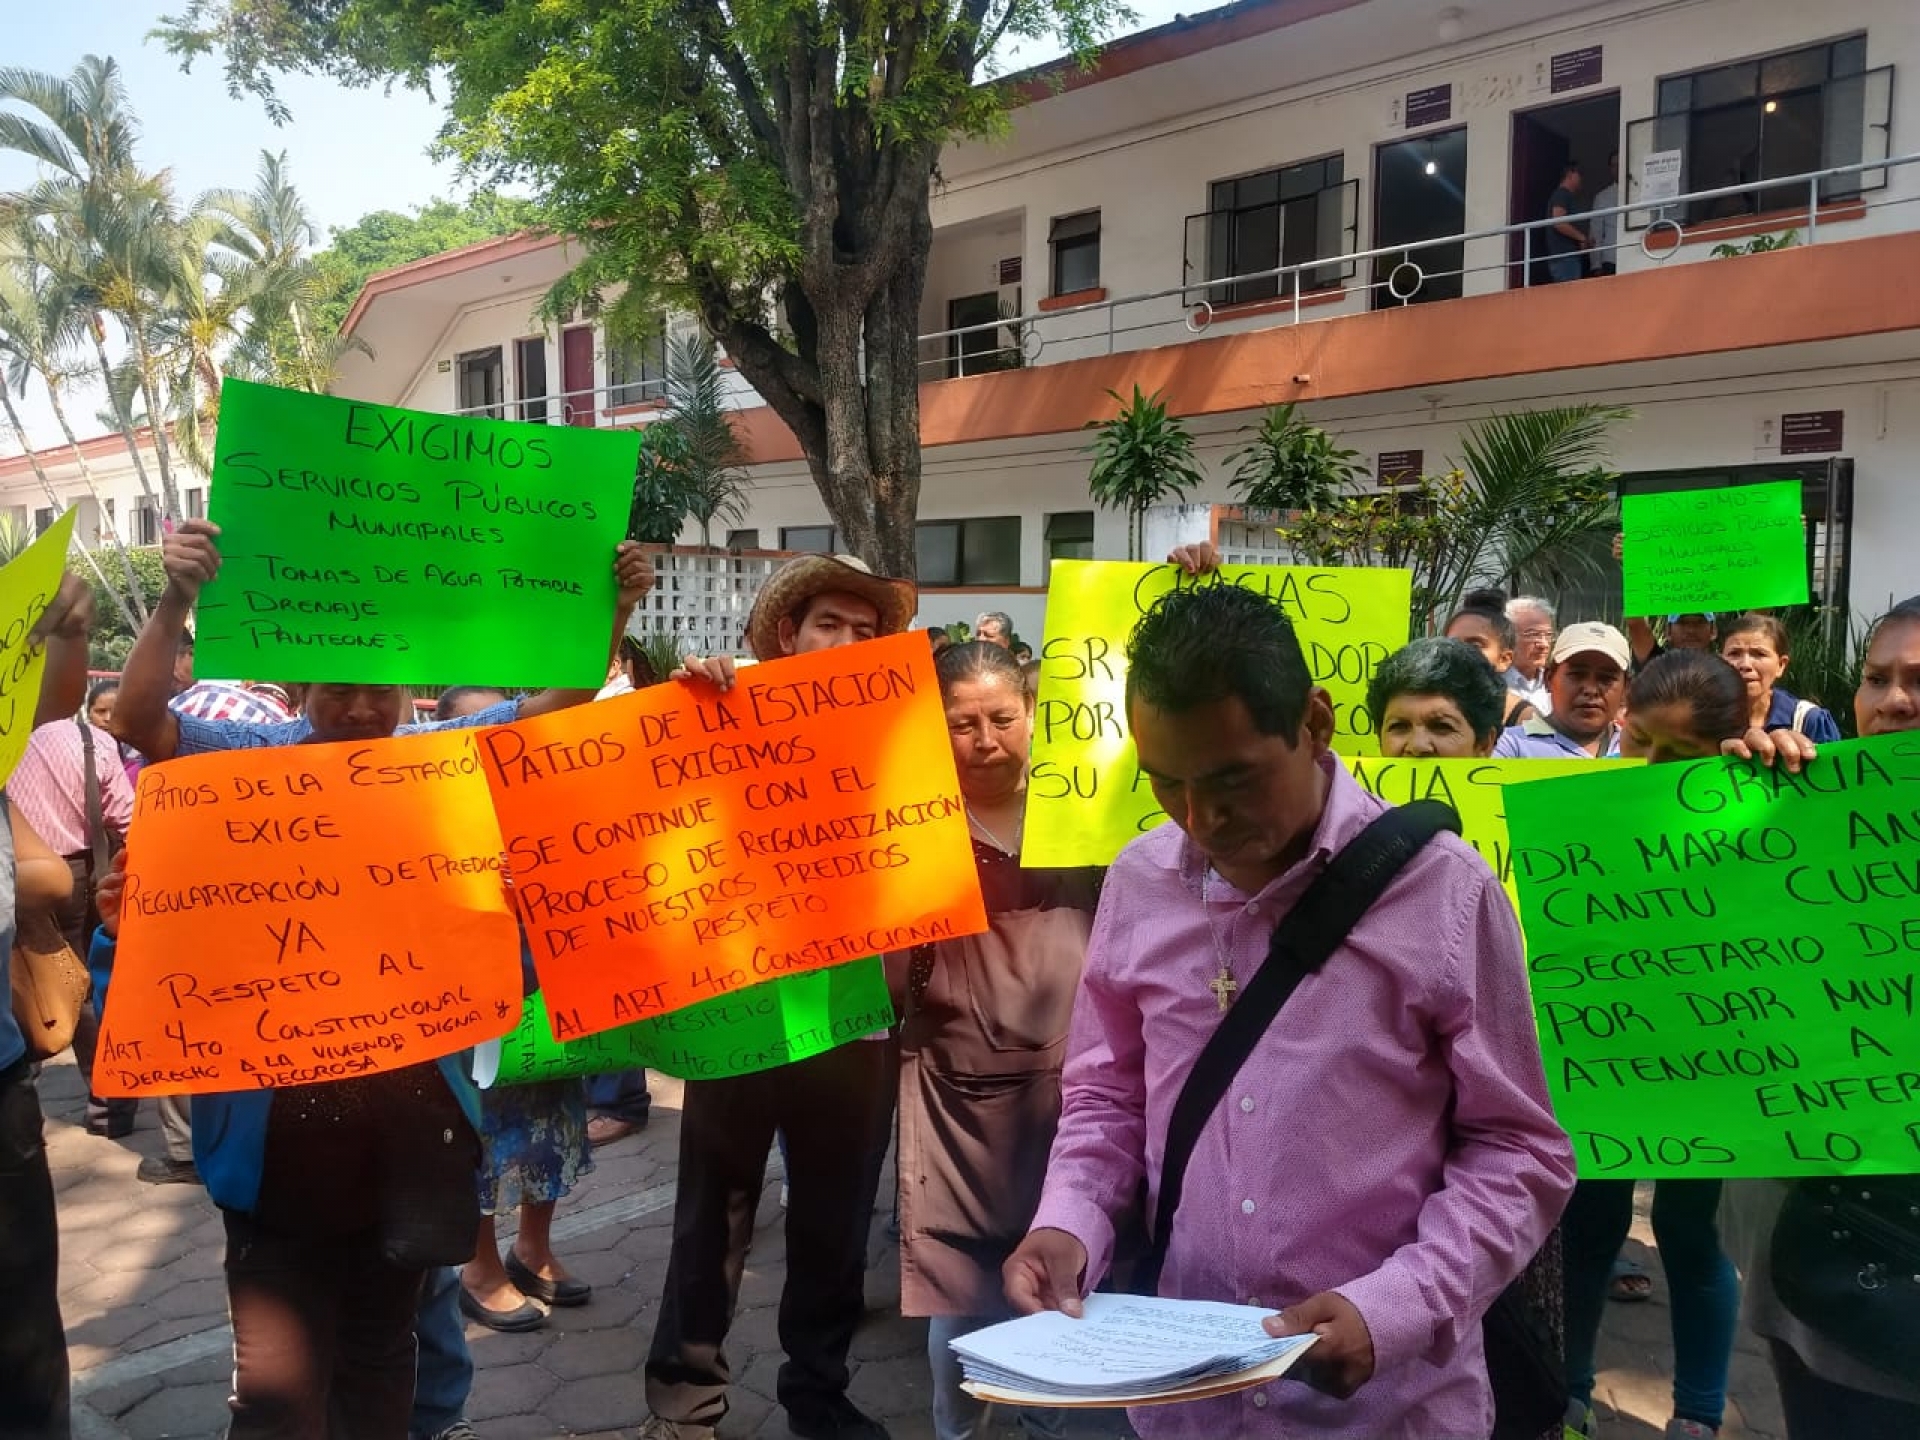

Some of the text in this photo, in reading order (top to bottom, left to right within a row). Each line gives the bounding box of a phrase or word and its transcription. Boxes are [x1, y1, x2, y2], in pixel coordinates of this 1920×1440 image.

[345, 405, 552, 469] EXIGIMOS
[223, 452, 420, 503] SERVICIOS
[328, 510, 505, 544] MUNICIPALES
[253, 554, 584, 596] TOMAS DE AGUA POTABLE
[242, 590, 379, 621] DRENAJE
[240, 619, 410, 651] PANTEONES
[486, 663, 916, 788] PATIOS DE LA ESTACIÓN
[1039, 700, 1123, 744] POR
[651, 735, 816, 789] EXIGIMOS
[1031, 761, 1098, 799] SU
[139, 772, 219, 816] PATIOS
[234, 776, 275, 800] DE
[285, 773, 323, 796] LA
[508, 766, 876, 875] SE CONTINUE CON EL
[225, 815, 343, 844] EXIGE
[1633, 826, 1797, 874] MARCO
[520, 793, 961, 925] PROCESO DE REGULARIZACIÓN
[122, 855, 504, 921] REGULARIZACIÓN DE PREDIO
[545, 843, 910, 960] DE NUESTROS PREDIOS
[1542, 886, 1717, 928] CANTU
[265, 917, 325, 963] YA
[693, 892, 829, 945] RESPETO
[157, 951, 424, 1008] RESPETO AL
[555, 1008, 592, 1038] AL
[691, 966, 746, 993] 4TO
[752, 918, 955, 975] CONSTITUCIONAL
[1530, 935, 1825, 989] SECRETARIO
[165, 1020, 223, 1059] 4TO
[256, 986, 473, 1042] CONSTITUCIONAL
[1542, 972, 1914, 1046] POR DAR MUY
[239, 1058, 256, 1073] A
[265, 1053, 294, 1068] LA
[416, 1010, 482, 1038] DIGNA
[1562, 1026, 1893, 1093] ATENCIÓN A
[1577, 1130, 1736, 1171] DIOS
[1784, 1130, 1863, 1163] LO
